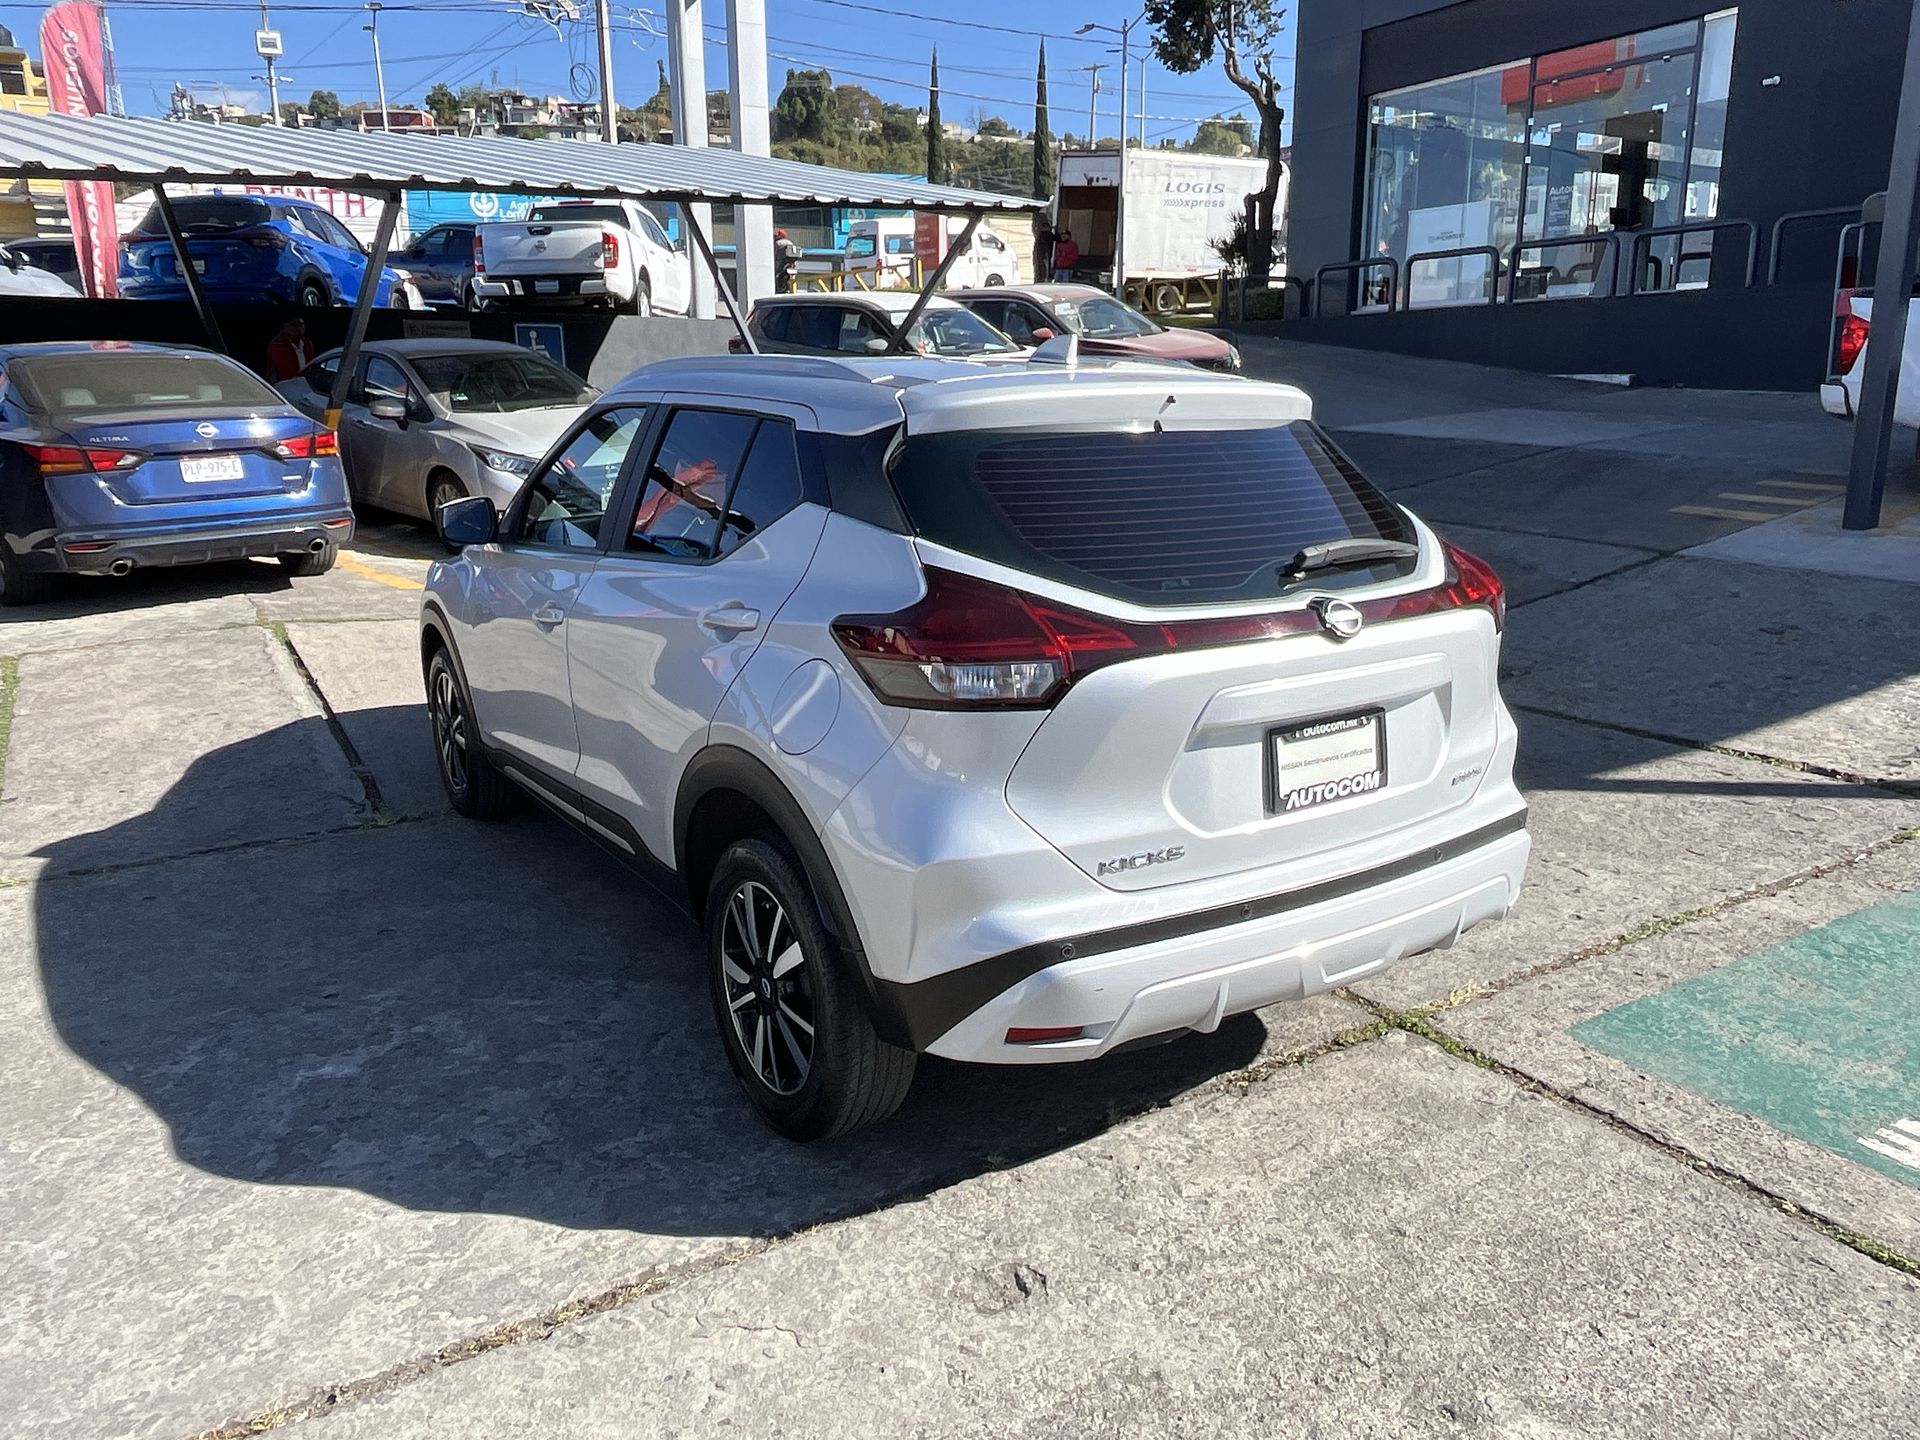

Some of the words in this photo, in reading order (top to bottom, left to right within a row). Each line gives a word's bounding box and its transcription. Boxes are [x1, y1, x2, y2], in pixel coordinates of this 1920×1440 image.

[1164, 182, 1226, 194] LOGIS
[1184, 198, 1225, 209] xpress
[89, 435, 130, 443] ALTIMA
[183, 460, 239, 476] PLP-975-E
[1303, 718, 1359, 738] autocom.mx
[1281, 760, 1303, 771] NISSAN
[1303, 754, 1340, 768] Seminuevos
[1340, 747, 1374, 760] Certificados
[1286, 770, 1381, 811] AUTOCOM
[1097, 845, 1186, 877] KICKS
